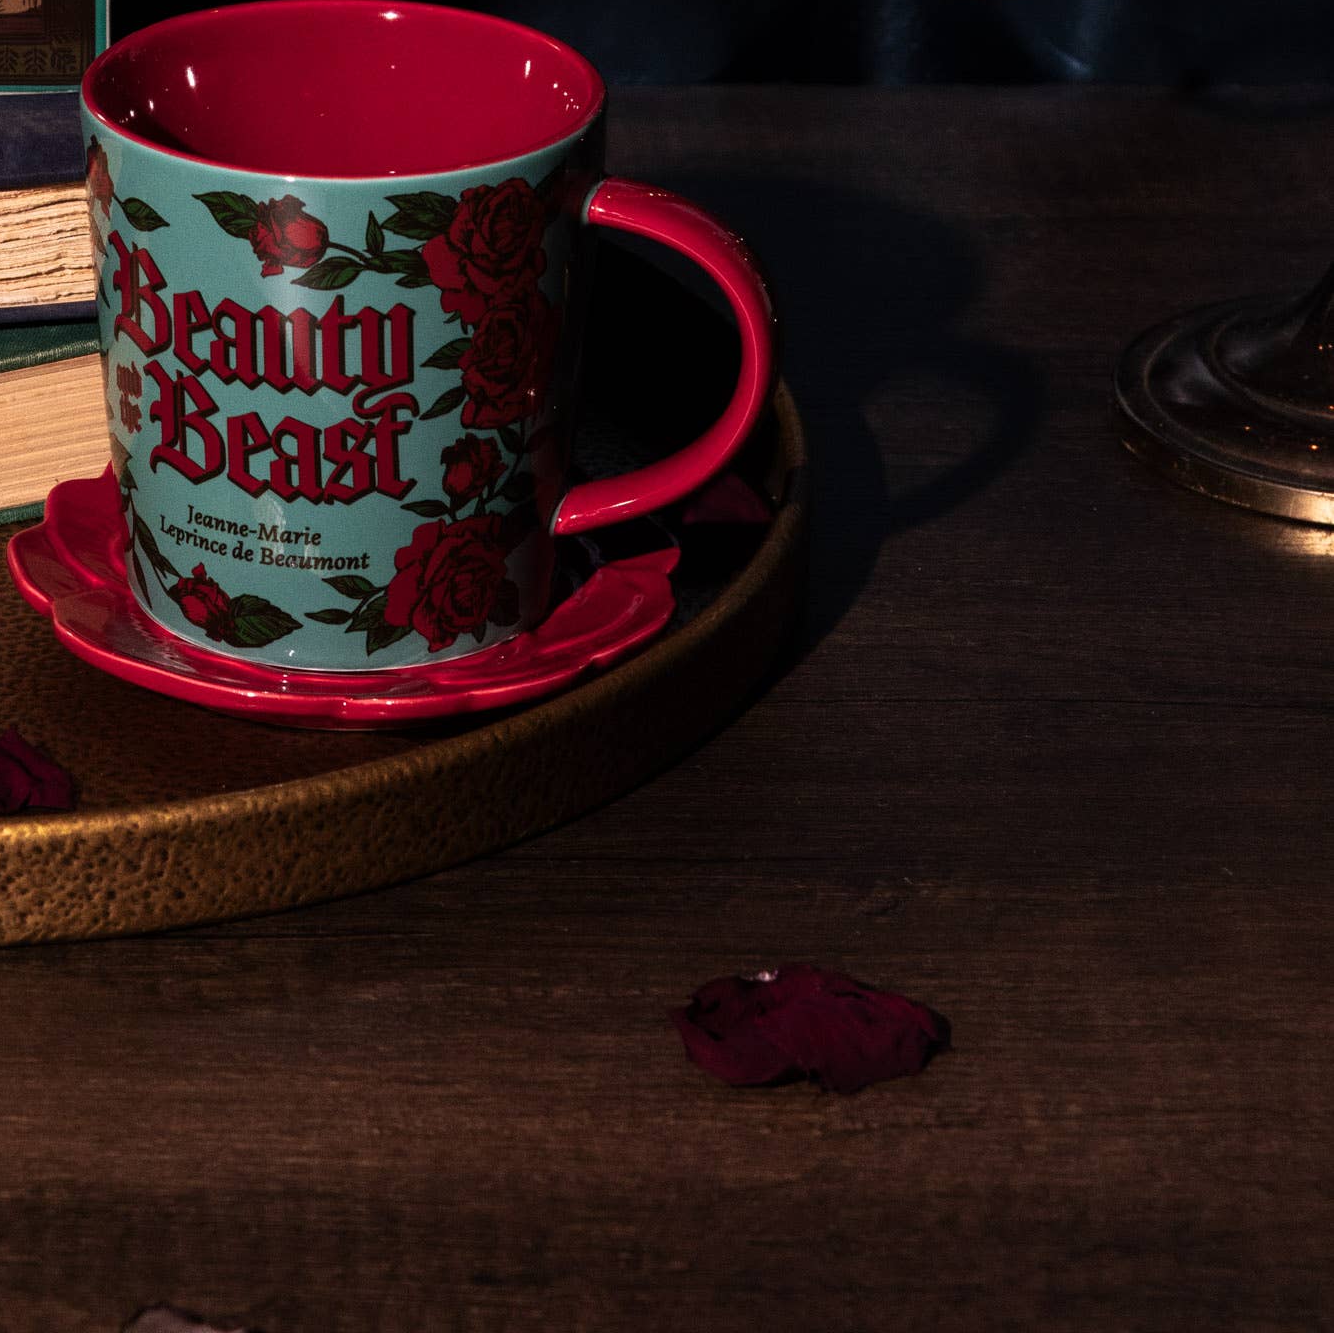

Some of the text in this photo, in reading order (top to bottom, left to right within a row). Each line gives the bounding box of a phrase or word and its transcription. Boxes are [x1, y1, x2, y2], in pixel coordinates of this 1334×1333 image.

[109, 230, 418, 419] Beauty
[143, 359, 418, 505] Beast
[160, 514, 370, 571] Leprince de Beaumont
[187, 505, 322, 546] Jeanne-Marie
